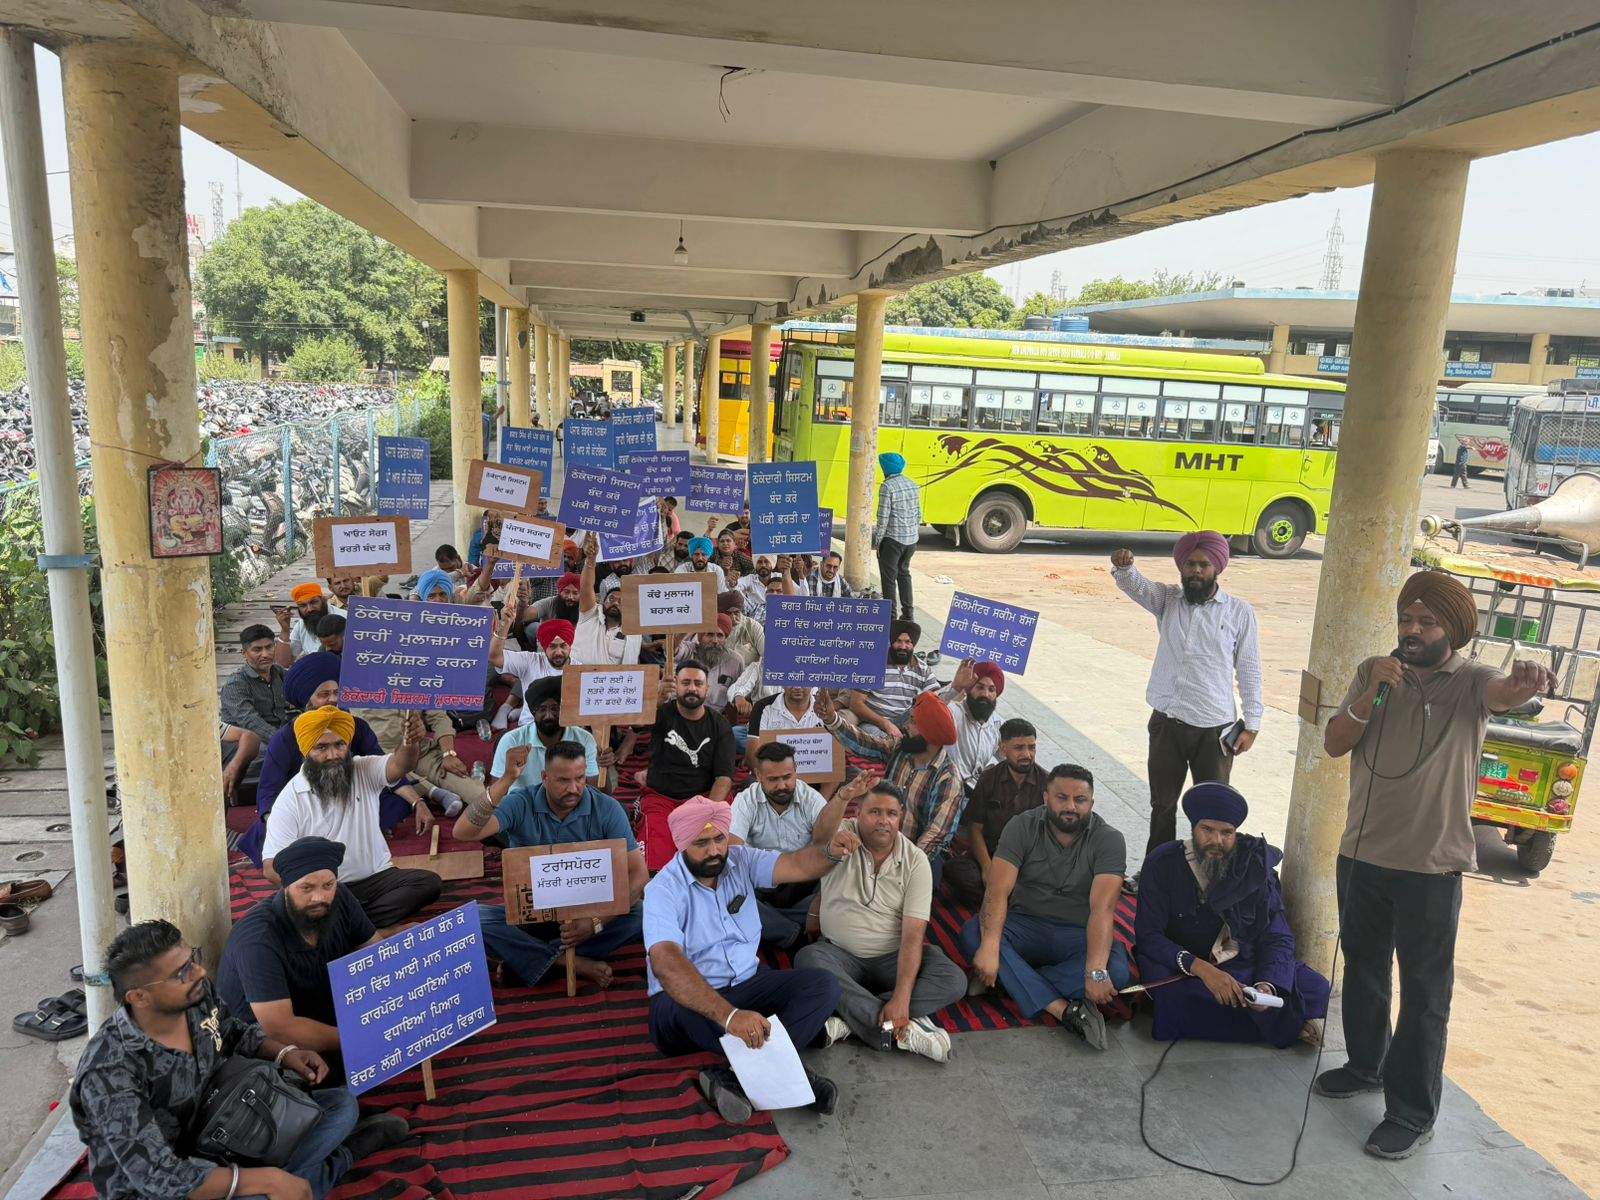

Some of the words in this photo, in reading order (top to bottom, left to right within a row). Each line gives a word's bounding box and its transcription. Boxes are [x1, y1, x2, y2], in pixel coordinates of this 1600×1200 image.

[1175, 452, 1244, 471] MHT
[571, 470, 607, 484] ਠੇਕੇਦਾਰੀ
[610, 477, 640, 490] ਸਿਸਟਮ
[752, 471, 782, 484] ਠੇਕੇਦਾਰੀ
[786, 470, 813, 484] ਸਿਸਟਮ
[588, 486, 602, 498] ਬੰਦ
[770, 490, 782, 504] ਬੰਦ
[594, 504, 618, 515] ਭਰਤੀ
[621, 508, 631, 516] ਦਾ
[778, 510, 798, 524] ਭਰਤੀ
[801, 513, 811, 523] ਦਾ
[504, 522, 526, 534] ਪੰਜਾਬ
[526, 528, 552, 539] ਸਰਕਾਰ
[340, 544, 361, 553] ਭਰਤੀ
[362, 542, 377, 552] ਬੰਦ
[768, 532, 788, 548] ਪ੍ਰਬੰਧ
[650, 606, 674, 615] ਬਹਾਲ
[781, 602, 802, 612] ਭਗਤ
[805, 599, 822, 612] ਸਿੰਘ
[826, 600, 836, 612] ਦੀ
[839, 602, 852, 613] ਪੱਗ
[856, 602, 869, 614] ਬੰਨ
[872, 603, 880, 614] ਕੇ
[953, 595, 990, 616] ਕਿਲੋਮੀਟਰ
[992, 607, 1016, 622] ਸਕੀਮ
[354, 604, 413, 622] ਠੇਕੇਦਾਰ
[420, 610, 488, 628] ਵਿਚੋਲਿਆਂ
[814, 618, 834, 630] ਆਈ
[838, 622, 853, 631] ਮਾਨ
[856, 622, 885, 632] ਸਰਕਾਰ
[353, 628, 393, 642] ਰਾਹੀਂ
[468, 636, 486, 649] ਦੀ
[971, 621, 997, 638] ਵਿਭਾਗ
[1000, 629, 1010, 642] ਦੀ
[1012, 633, 1028, 648] ਲੁੱਟ
[858, 640, 876, 650] ਨਾਲ
[946, 640, 986, 658] ਕਰਵਾਉਣਾ
[988, 648, 1003, 662] ਬੰਦ
[356, 649, 430, 668] ਲੁੱਟ/ਸ਼ੋਸ਼ਣ
[436, 656, 478, 670] ਕਰਨਾ
[794, 654, 830, 664] ਵਧਾਇਆ
[834, 654, 860, 666] ਪਿਆਰ
[386, 673, 414, 688] ਬੰਦ
[419, 674, 445, 689] ਕਰੋ
[764, 669, 786, 680] ਵੇਚਣ
[852, 672, 876, 684] ਵਿਭਾਗ
[542, 856, 602, 873] ਟਰਾਂਸਪੋਰਟ
[538, 876, 562, 888] ਮੰਤਰੀ
[566, 874, 608, 888] ਮੁਰਦਾਬਾਦ
[348, 954, 375, 976] ਭਗਤ
[378, 942, 400, 963] ਸਿੰਘ
[403, 933, 416, 950] ਦੀ
[418, 926, 436, 943] ਪੱਗ
[438, 918, 454, 934] ਬੰਨ
[456, 910, 465, 926] ਕੇ
[344, 986, 366, 1006] ਸੱਤਾ
[370, 974, 392, 994] ਵਿੱਚ
[394, 958, 420, 980] ਆਈ
[423, 950, 442, 968] ਮਾਨ
[444, 932, 477, 958] ਸਰਕਾਰ
[360, 994, 405, 1026] ਕਾਰਪੋਰੇਟ
[407, 970, 450, 1002] ਘਰਾਣਿਆਂ
[454, 960, 474, 980] ਨਾਲ
[383, 1010, 427, 1042] ਵਧਾਇਆ
[430, 992, 462, 1018] ਪਿਆਰ
[350, 1064, 377, 1087] ਵੇਚਣ
[380, 1049, 403, 1072] ਲੱਗੀ
[406, 1023, 454, 1058] ਟਰਾਂਸਪੋਰਟ
[457, 1006, 486, 1030] ਵਿਭਾਗ
